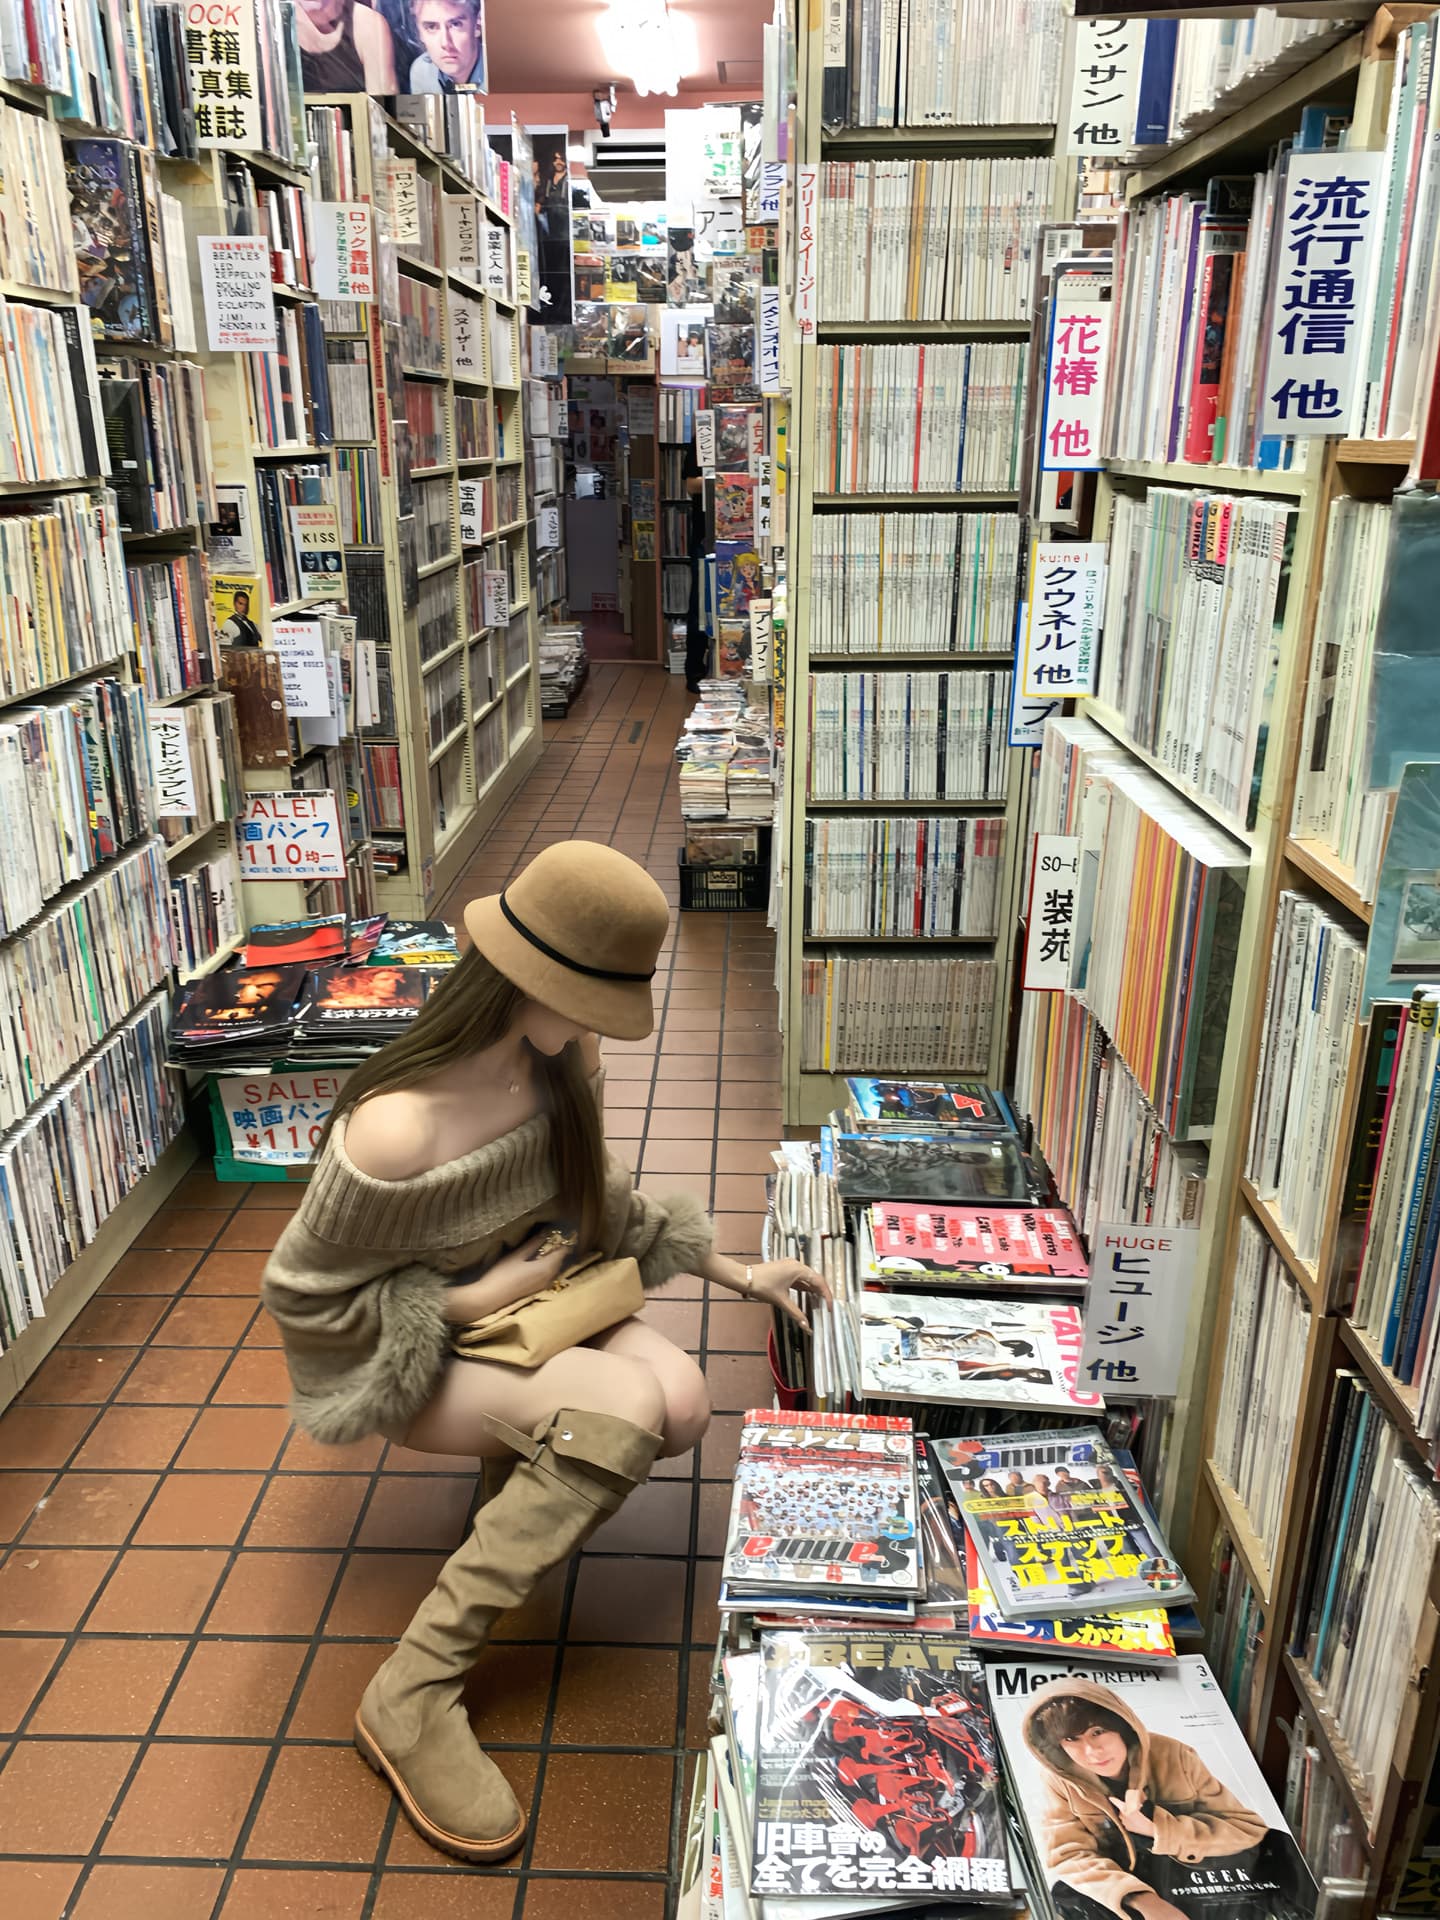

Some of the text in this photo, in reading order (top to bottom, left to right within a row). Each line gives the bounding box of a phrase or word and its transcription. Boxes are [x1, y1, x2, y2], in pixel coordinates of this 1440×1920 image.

[190, 69, 252, 99] 真集
[1073, 123, 1121, 144] 他
[1278, 176, 1371, 355] 流行通信
[351, 282, 371, 294] 他
[1053, 315, 1102, 395] 花椿
[1271, 378, 1343, 420] 他
[1049, 418, 1092, 457] 他
[302, 532, 337, 543] KISS
[1036, 566, 1077, 651] クウネル
[1033, 663, 1074, 685] 他
[245, 799, 318, 818] ALE!
[237, 822, 331, 841] 画パンフ
[239, 843, 336, 865] 110均一
[243, 1078, 340, 1105] SALE!
[1105, 1235, 1173, 1251] HUGE
[1096, 1252, 1152, 1345] ヒュージ
[1086, 1358, 1140, 1383] 他
[996, 1511, 1125, 1536] ストリート
[1015, 1533, 1127, 1562] スナップ
[1091, 1669, 1162, 1684] PREPPY
[1196, 1664, 1208, 1677] 3
[752, 1855, 1010, 1893] 全てを完全網羅
[1190, 1867, 1251, 1885] GEEK
